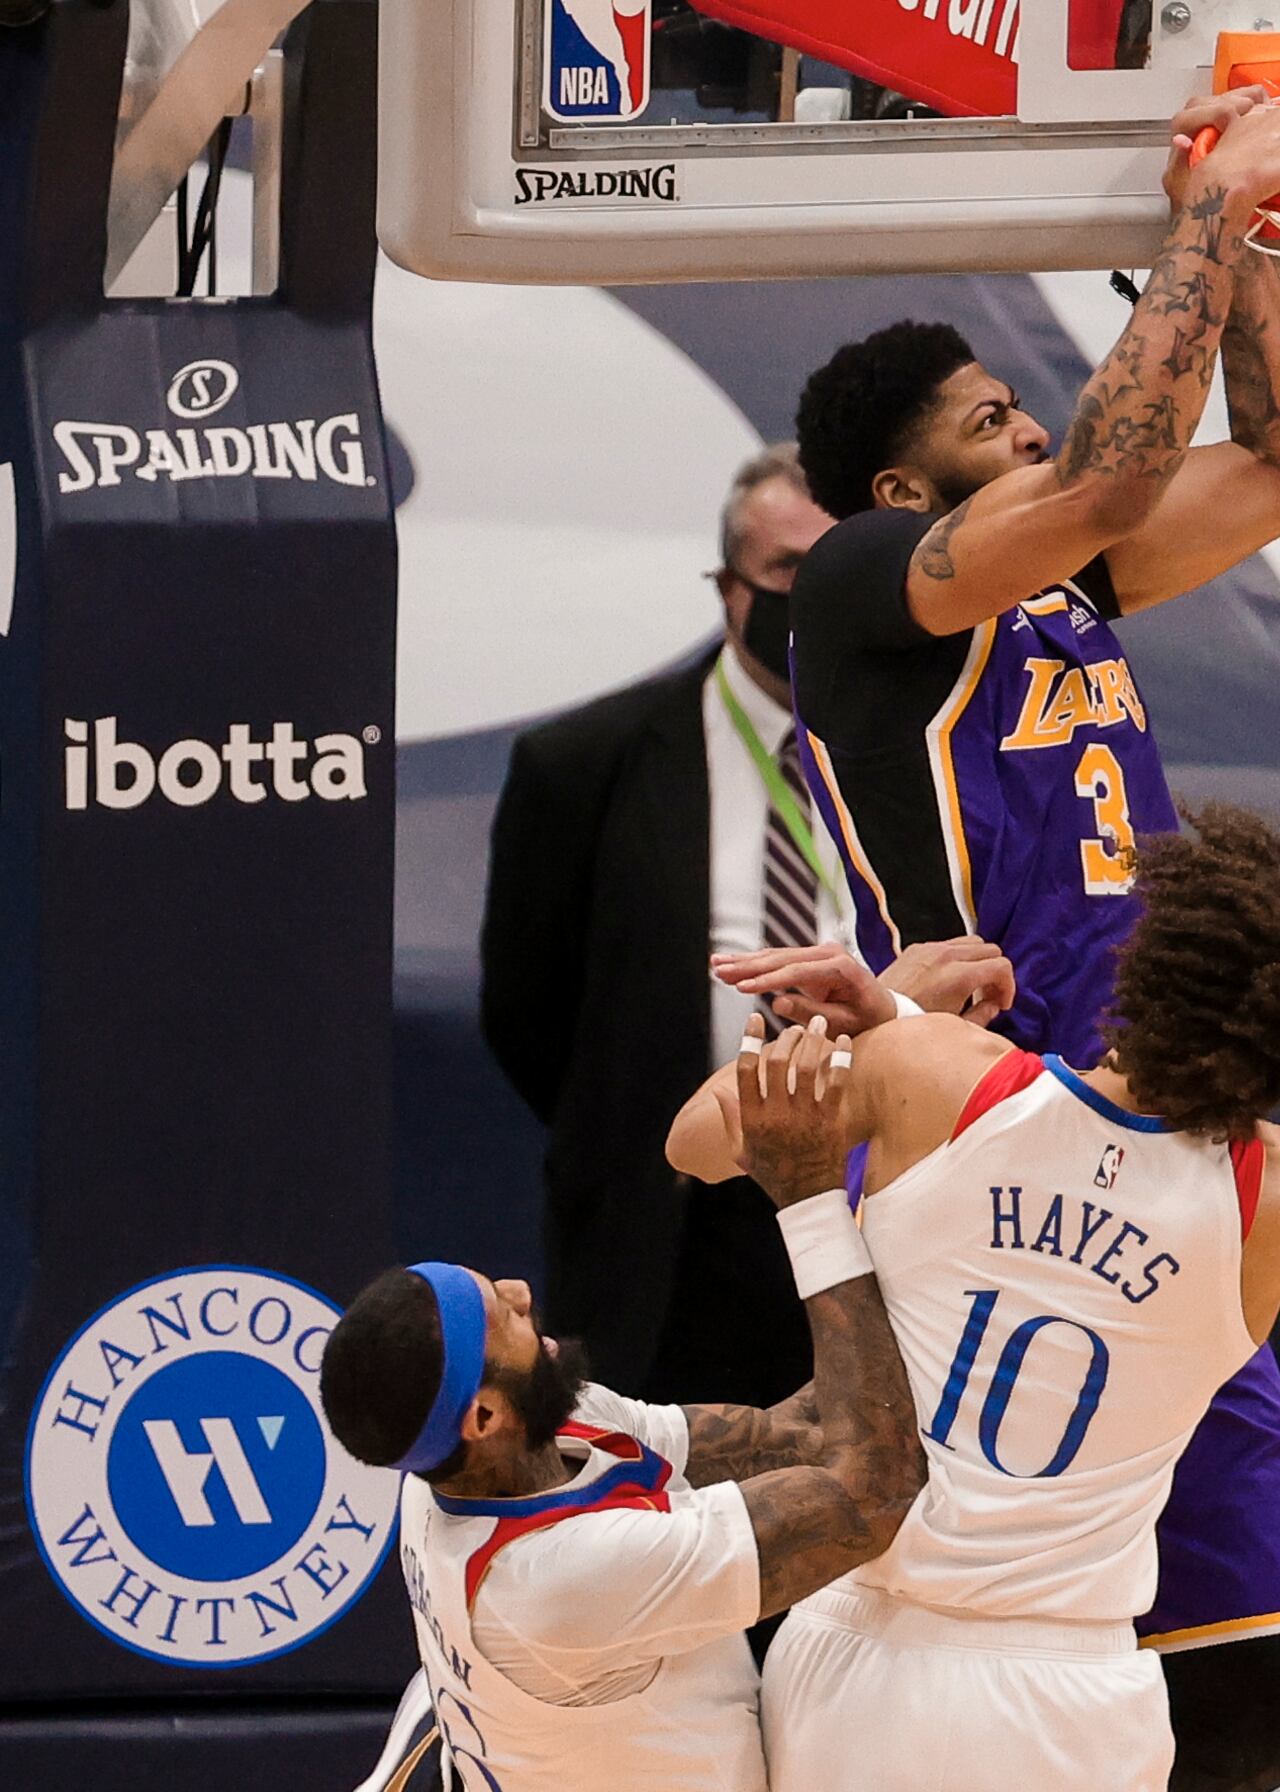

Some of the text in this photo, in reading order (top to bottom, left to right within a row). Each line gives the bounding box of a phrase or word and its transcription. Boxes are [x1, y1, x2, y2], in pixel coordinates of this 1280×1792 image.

[559, 66, 609, 106] NBA
[514, 164, 676, 205] SPALDING
[53, 412, 367, 494] SPALDING
[1074, 742, 1138, 896] 3
[989, 1186, 1181, 1304] HAYES
[51, 1287, 333, 1443] HANCOC
[921, 1289, 1110, 1479] 10
[56, 1494, 377, 1645] WHITNEY
